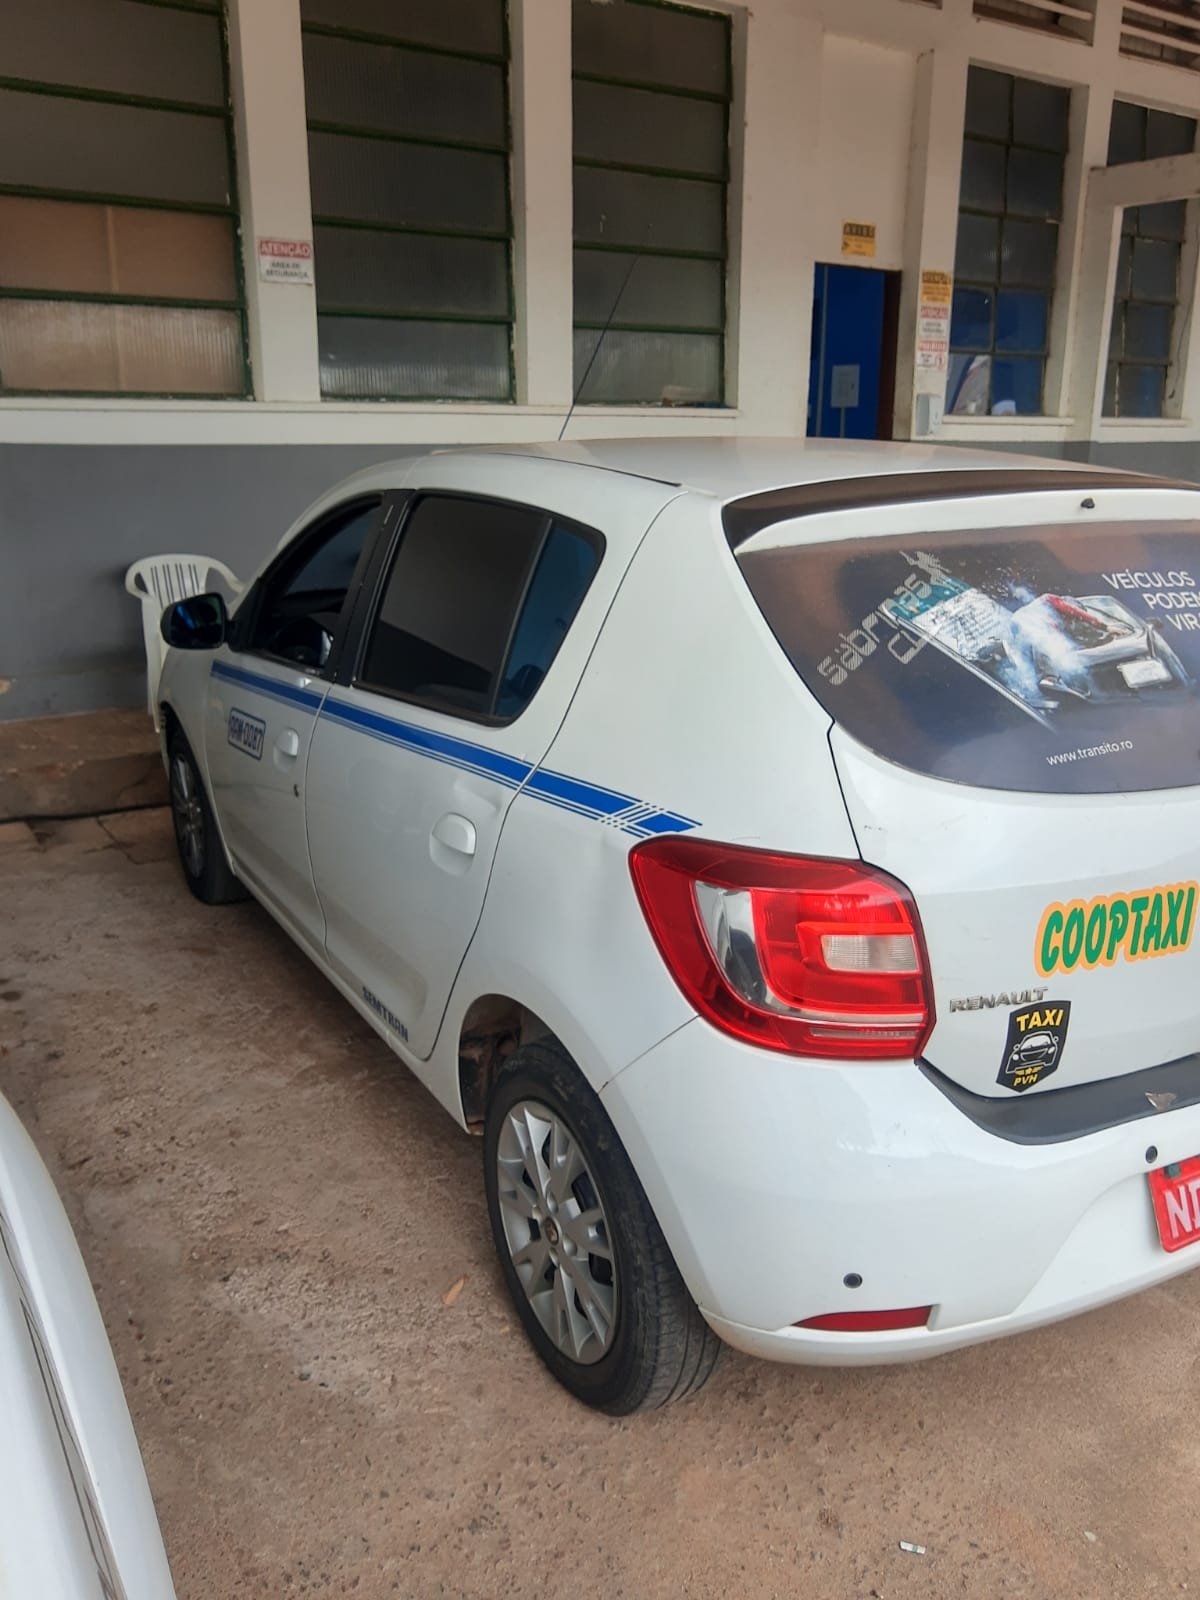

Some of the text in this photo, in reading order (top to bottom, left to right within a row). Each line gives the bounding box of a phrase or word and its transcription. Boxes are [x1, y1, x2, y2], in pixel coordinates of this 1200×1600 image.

[260, 240, 311, 258] ATENÇÃO
[1101, 568, 1196, 590] VEÍCULOS
[1165, 612, 1200, 631] VIR
[1046, 740, 1133, 766] www.transito.ro
[1039, 886, 1196, 973] COOPTAXI
[949, 986, 1048, 1013] RENAULT
[1016, 1008, 1065, 1032] TAXI
[1012, 1073, 1039, 1087] PVH
